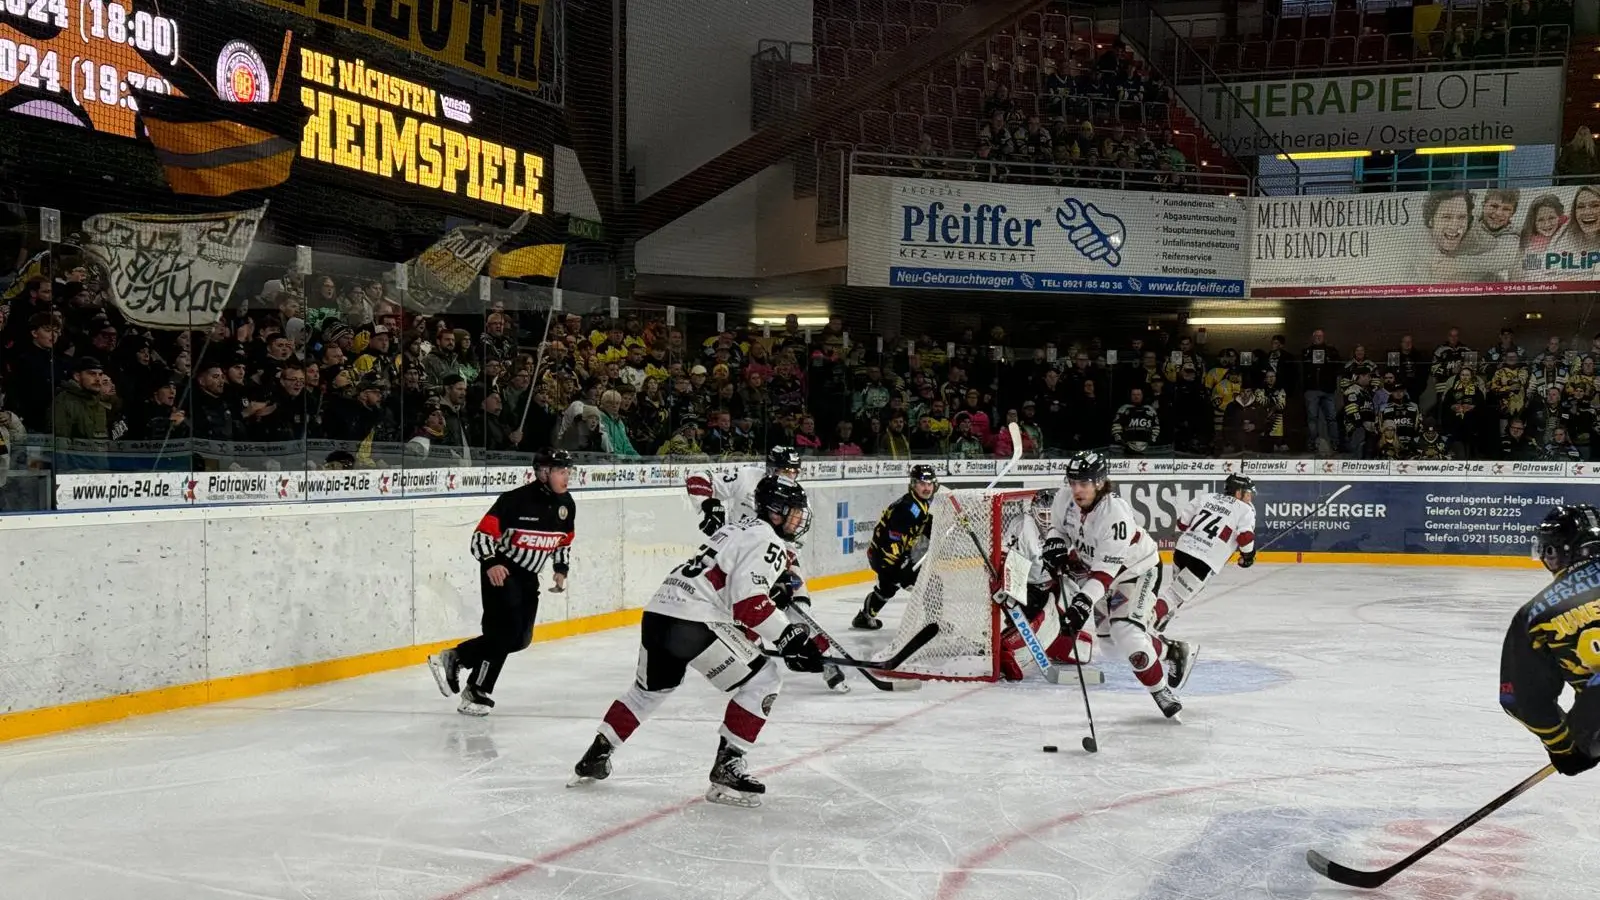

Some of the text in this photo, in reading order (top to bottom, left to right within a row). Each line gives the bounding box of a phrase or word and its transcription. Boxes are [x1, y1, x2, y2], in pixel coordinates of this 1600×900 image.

[300, 47, 334, 87] DIE
[338, 58, 436, 117] NÄCHSTEN
[1380, 119, 1514, 145] Osteopathie
[300, 86, 544, 215] HEIMSPIELE
[902, 186, 961, 197] ANDREAS
[1163, 199, 1215, 209] Kundendienst
[1163, 213, 1237, 224] Abgasuntersuchung
[1258, 197, 1410, 229] MEIN MÖBELHAUS
[901, 202, 1041, 247] Pfeiffer
[1163, 226, 1235, 238] Hauptuntersuchung
[1256, 231, 1369, 259] IN BINDLACH
[1162, 252, 1212, 262] Reifenservice
[1162, 265, 1217, 275] Motordiagnose
[897, 270, 1014, 288] Neu-Gebrauchtwagen
[1063, 280, 1082, 288] 0921
[1149, 280, 1240, 294] www.kfzpfeiffer.de
[1154, 461, 1215, 473] www.pio-24.de
[1243, 461, 1288, 472] Piotrowski
[1342, 462, 1389, 471] Piotrowski
[1417, 463, 1485, 473] www.pio-24.de
[1513, 463, 1564, 473] Piotrowski
[73, 480, 169, 502] www.pio-24.de
[208, 474, 267, 492] Piotrowski
[298, 477, 370, 495] www.pio-24.de
[392, 472, 438, 486] Piotrowski
[462, 471, 517, 487] www.pio-24.de
[591, 467, 635, 482] www.pio-24.de
[651, 466, 680, 479] Piotrowski
[1426, 494, 1564, 506] Generalagentur Helge Jüstel
[1265, 502, 1386, 518] NÜRNBERGER
[1426, 507, 1521, 517] Telefon 0921 82225
[1111, 521, 1126, 540] 10
[1190, 509, 1222, 539] 74
[1265, 520, 1350, 531] VERSICHERUNG
[1425, 521, 1500, 532] Generalagentur
[517, 534, 560, 548] PENNY
[1425, 533, 1460, 542] Telefon
[1462, 534, 1486, 543] 0921
[764, 542, 787, 572] 55
[1018, 621, 1049, 669] POLYGON
